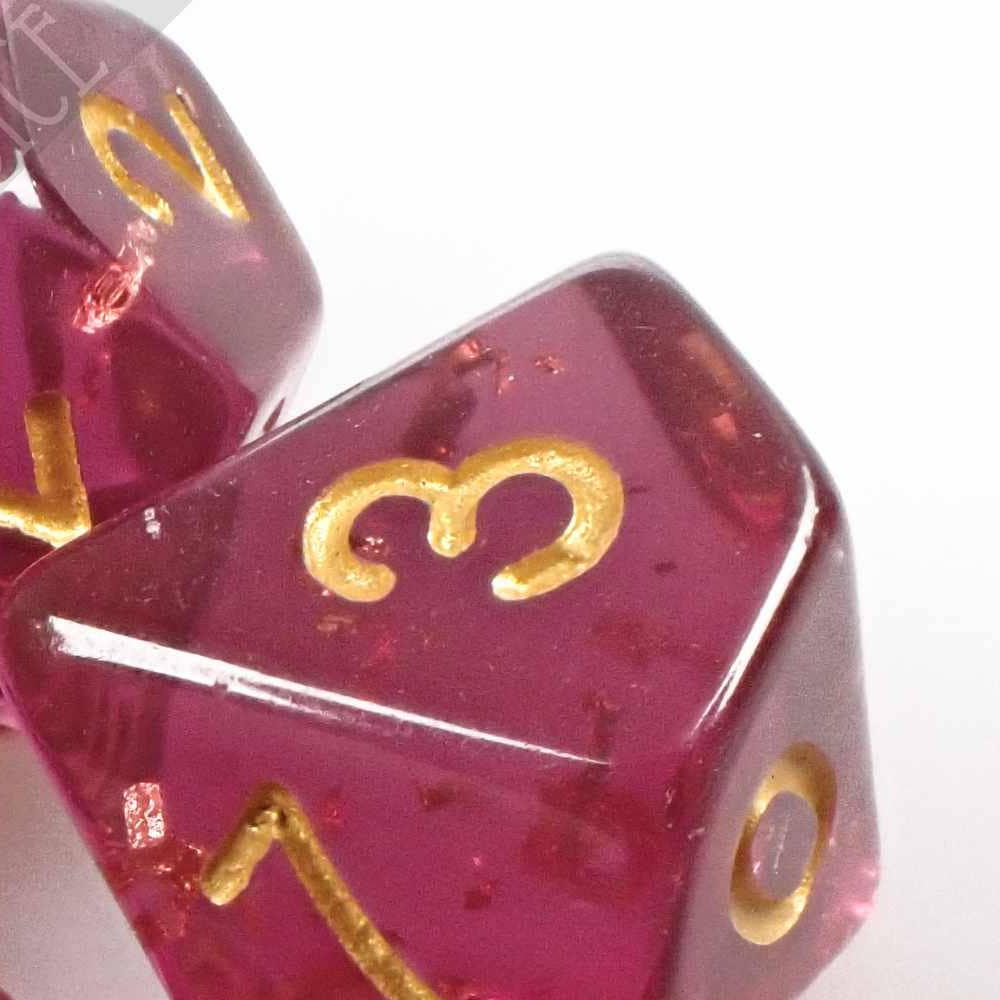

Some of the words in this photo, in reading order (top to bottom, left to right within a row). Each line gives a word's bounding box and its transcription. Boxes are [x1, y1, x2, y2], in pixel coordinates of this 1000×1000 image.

[80, 92, 252, 226] 2
[303, 434, 625, 602] 3
[729, 742, 838, 946] 0
